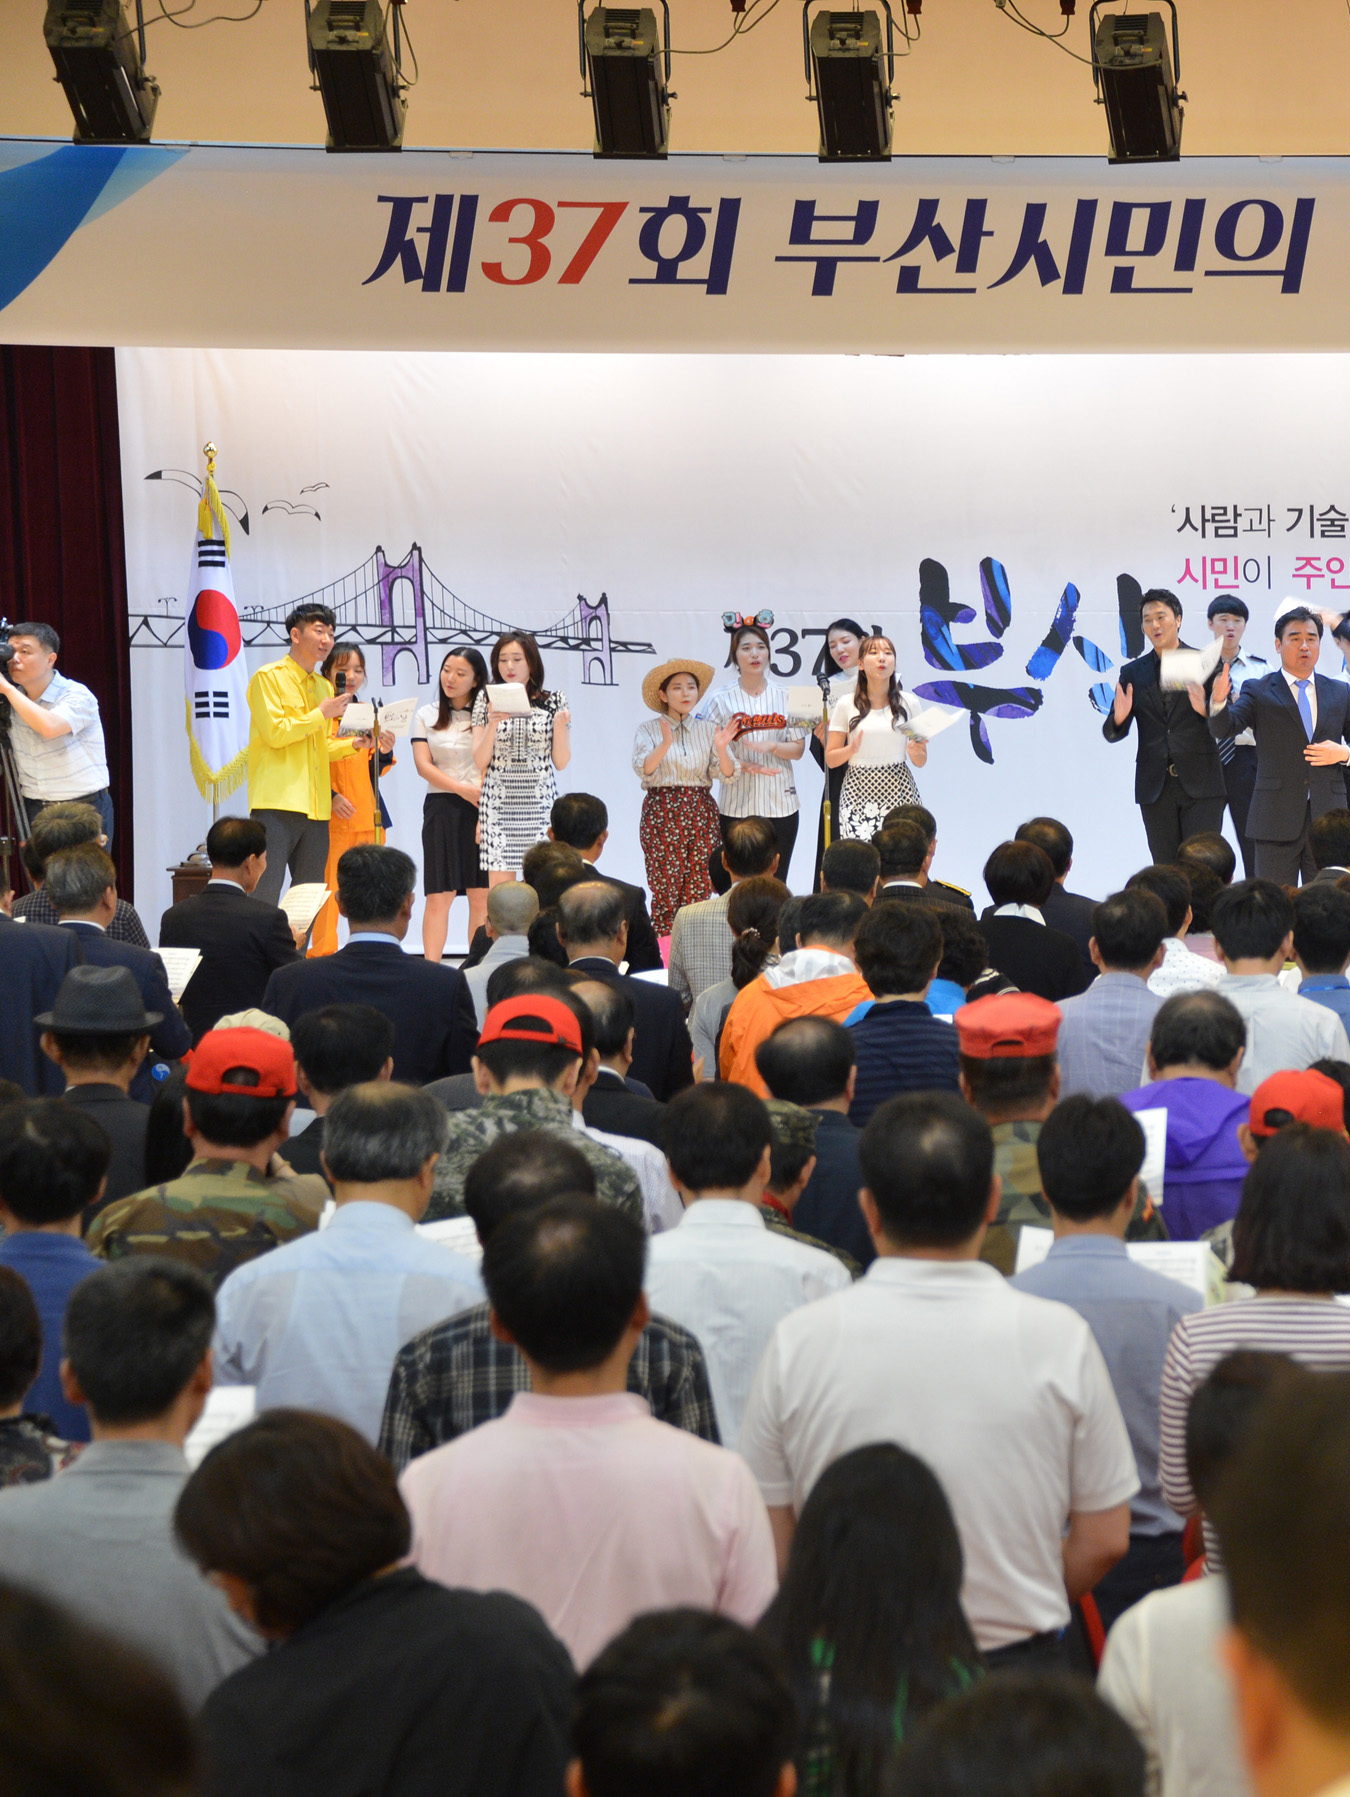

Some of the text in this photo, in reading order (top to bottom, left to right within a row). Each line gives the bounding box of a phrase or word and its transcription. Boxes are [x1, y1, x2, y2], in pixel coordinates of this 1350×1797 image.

[362, 193, 742, 296] 제37회
[775, 197, 1316, 297] 부산시민의
[1176, 555, 1272, 591] 시민이
